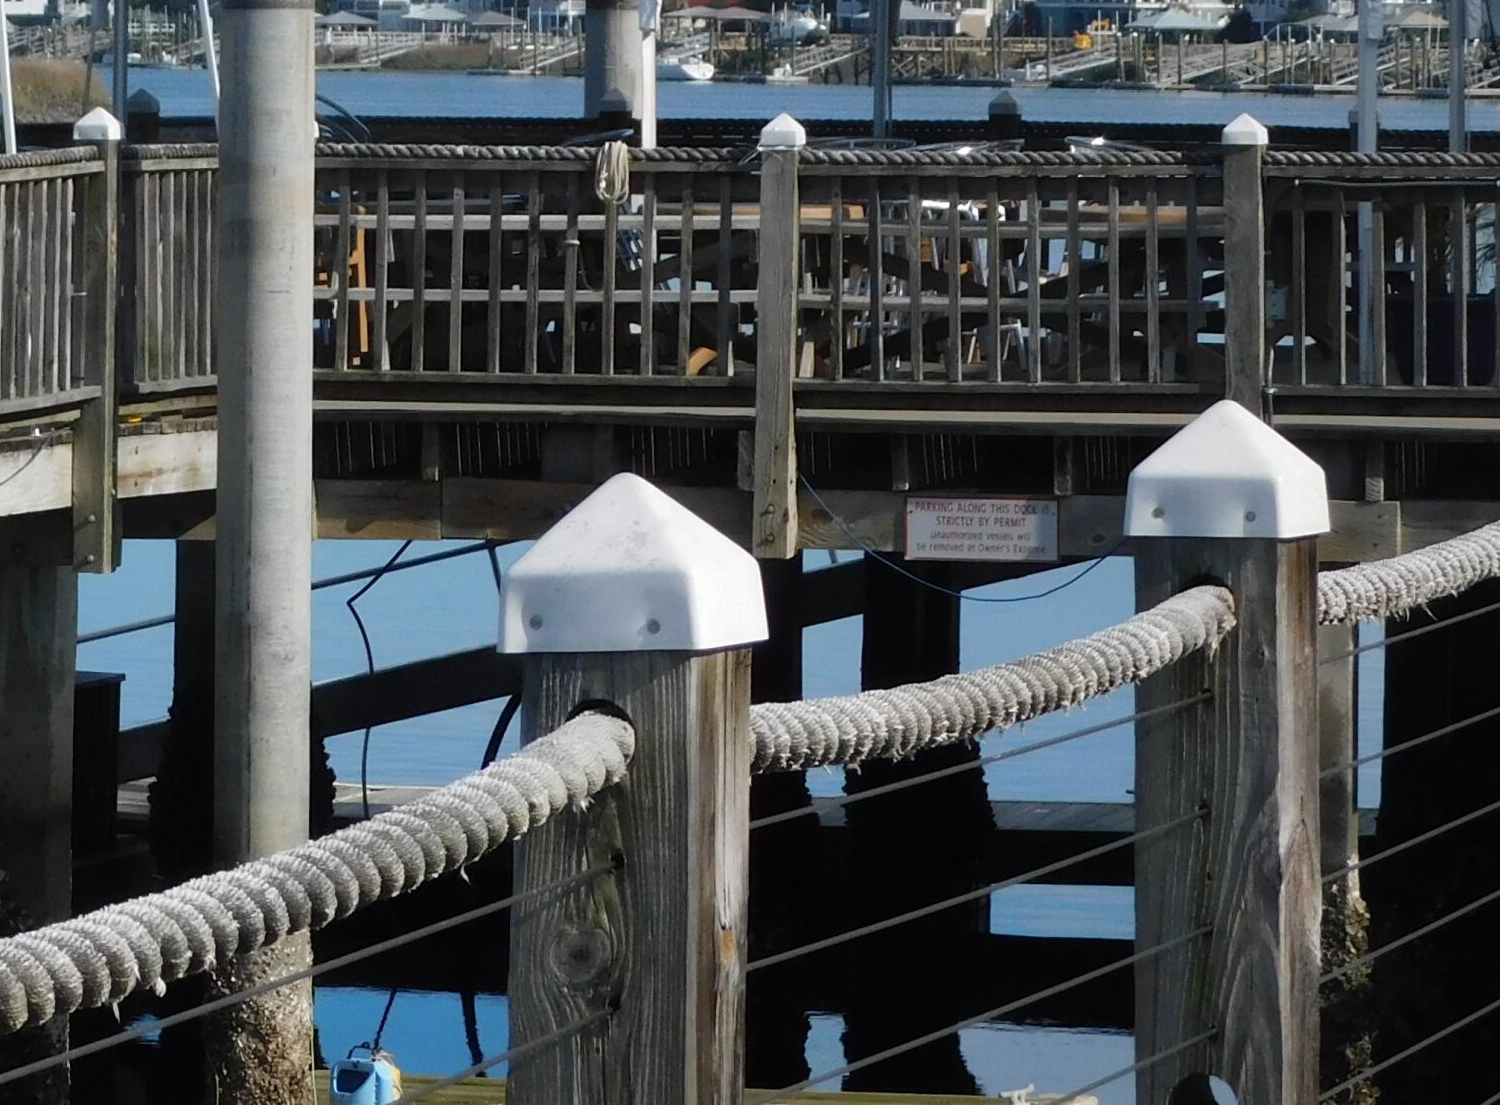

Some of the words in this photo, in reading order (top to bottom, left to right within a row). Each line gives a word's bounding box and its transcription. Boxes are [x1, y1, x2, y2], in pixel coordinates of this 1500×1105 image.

[915, 501, 954, 513] PARKING
[956, 502, 988, 514] ALONG
[991, 503, 1011, 514] THIS
[936, 515, 973, 526] STRICTLY
[978, 516, 990, 527] BY
[994, 517, 1027, 527] PERMIT
